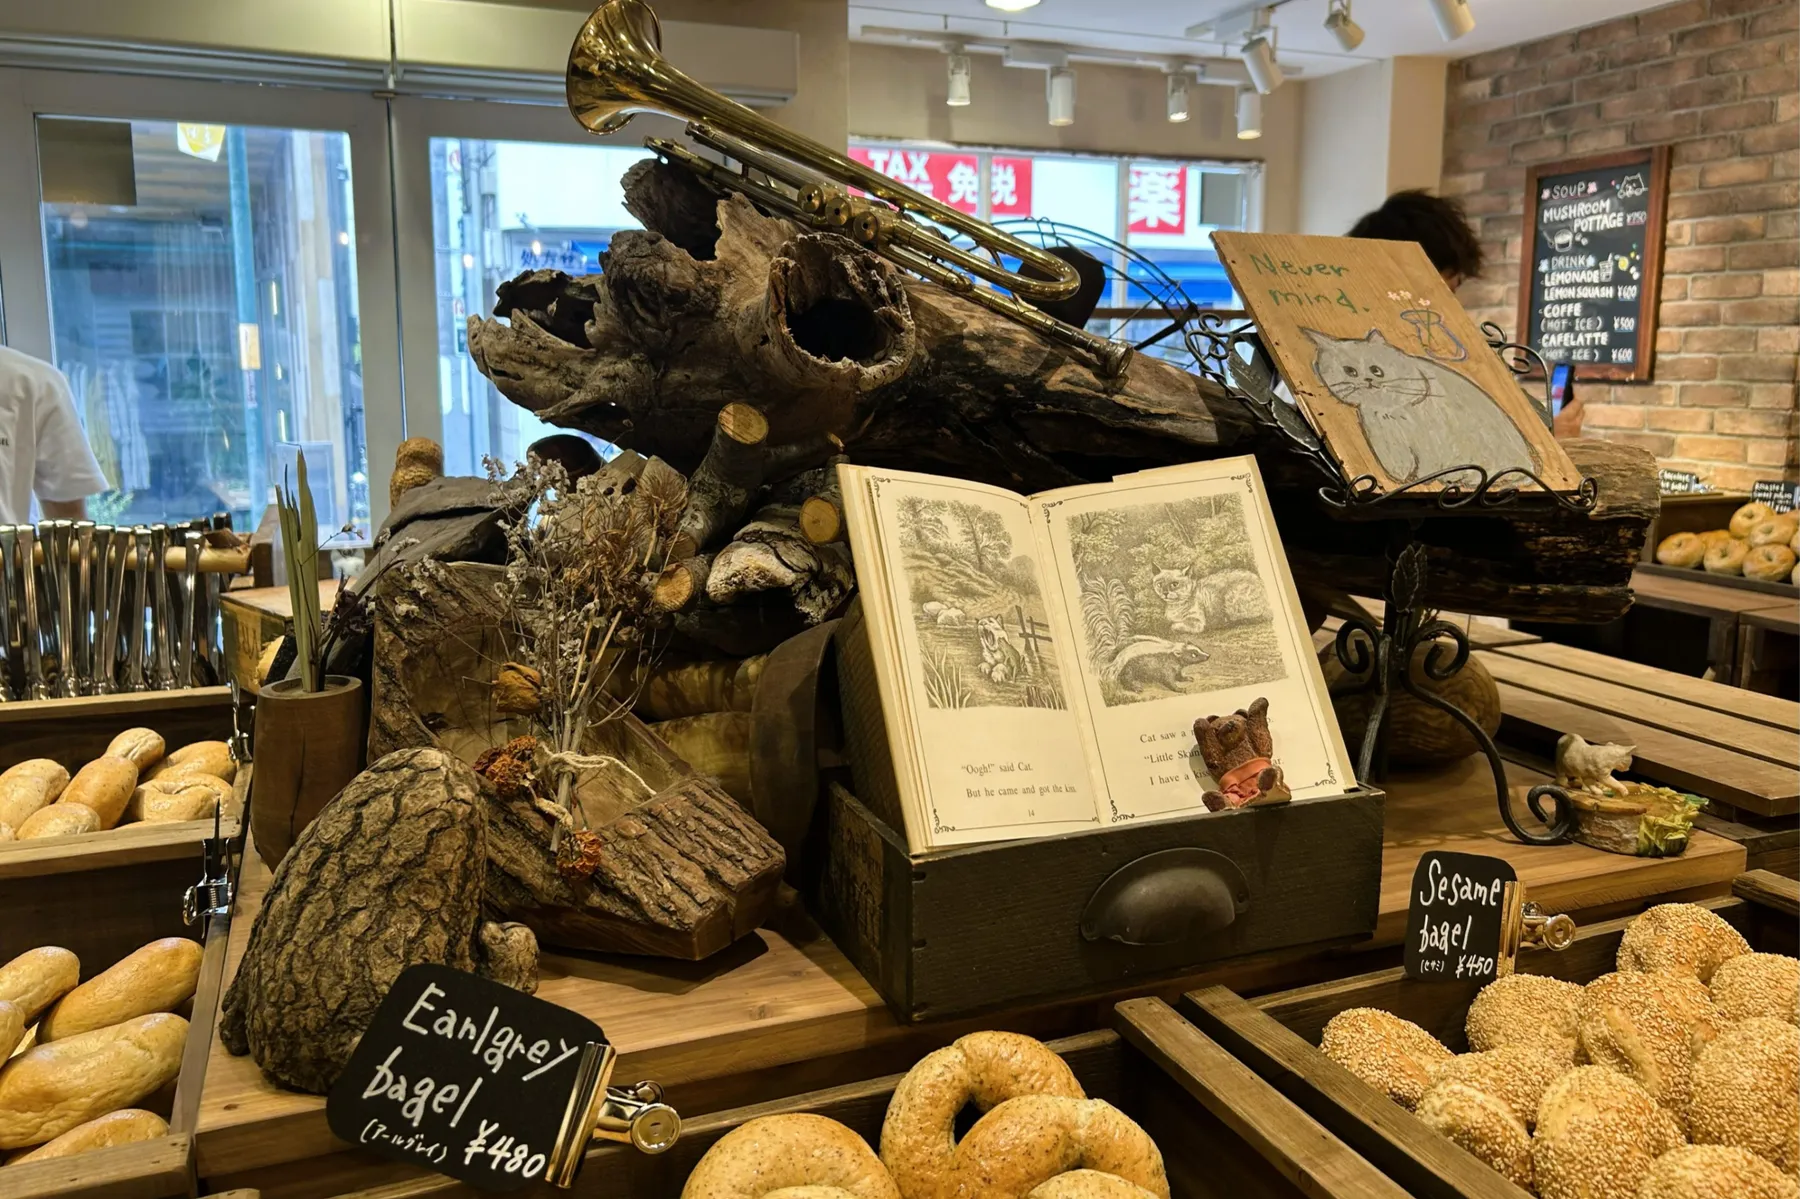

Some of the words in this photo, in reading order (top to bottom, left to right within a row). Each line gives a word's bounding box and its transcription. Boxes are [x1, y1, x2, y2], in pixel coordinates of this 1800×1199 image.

[867, 150, 930, 181] TAX
[1129, 165, 1181, 228] 薬
[1551, 180, 1586, 199] SOUP
[1543, 198, 1610, 223] MUSHROOM
[1573, 211, 1624, 233] POTTAGE
[1250, 253, 1350, 277] Never
[1551, 255, 1586, 270] DRINK
[1544, 269, 1600, 287] LEMONADE
[1268, 283, 1370, 314] mind.
[1544, 289, 1576, 301] LEMON
[1577, 286, 1614, 299] SQUASH
[1543, 302, 1582, 318] COFFE
[1139, 733, 1157, 744] Cat
[1160, 732, 1177, 741] saw
[1180, 730, 1187, 738] a
[999, 762, 1016, 773] said
[1017, 761, 1034, 772] Cat.
[1144, 752, 1174, 764] “Little
[1177, 748, 1202, 760] Skun
[1149, 776, 1155, 786] I
[1158, 772, 1180, 783] have
[966, 787, 982, 798] But
[985, 786, 995, 797] he
[998, 787, 1019, 797] came
[1021, 784, 1036, 795] and
[1038, 784, 1051, 797] got
[1052, 783, 1063, 794] the
[1027, 808, 1036, 818] 14
[1420, 858, 1501, 907] Sesame
[1418, 913, 1473, 956] bagel
[1455, 953, 1494, 979] ¥450
[402, 982, 579, 1081] Earlgrey
[362, 1045, 483, 1128] bagel
[463, 1119, 546, 1179] ¥480
